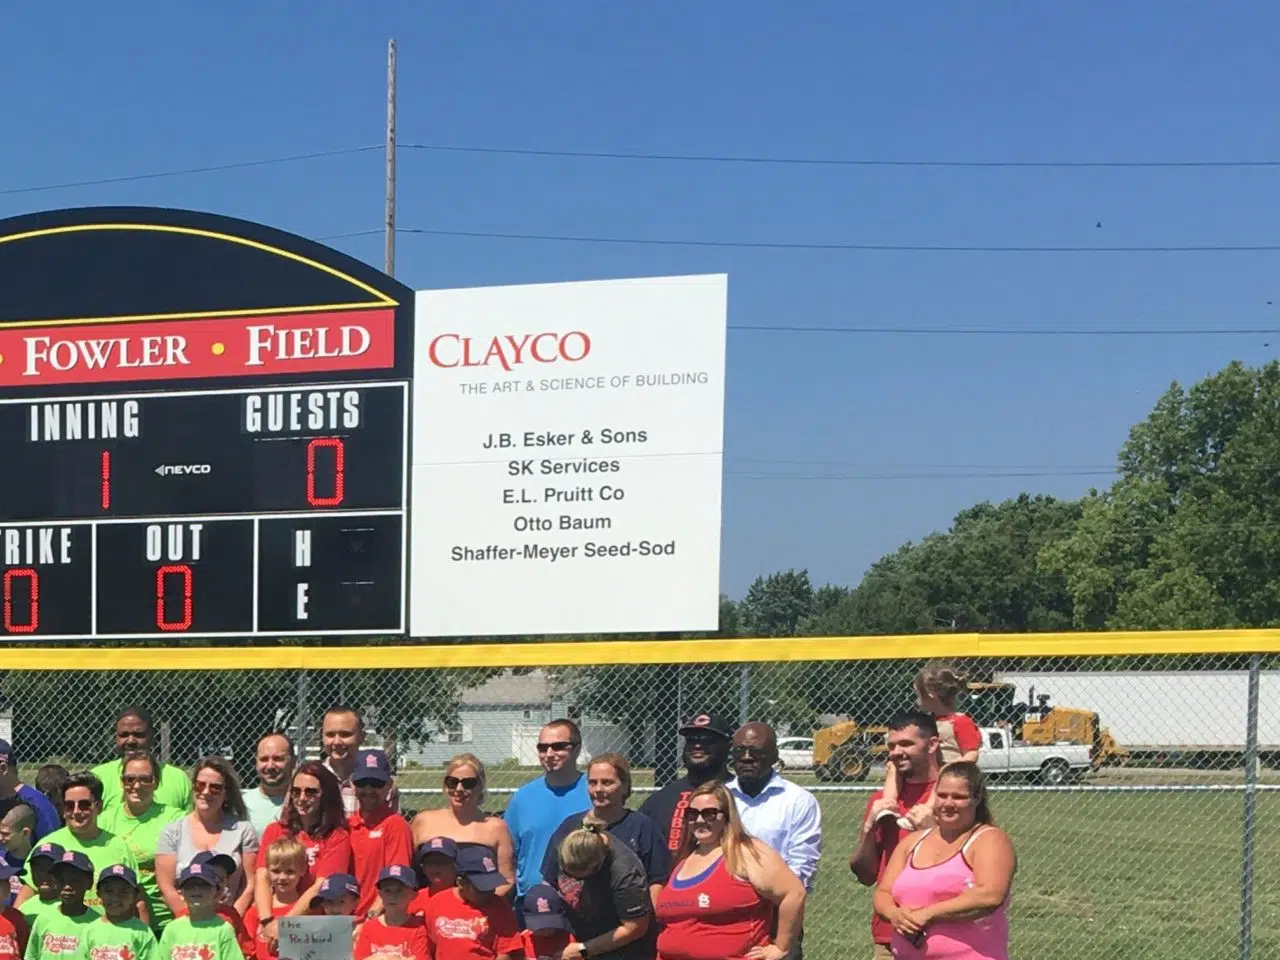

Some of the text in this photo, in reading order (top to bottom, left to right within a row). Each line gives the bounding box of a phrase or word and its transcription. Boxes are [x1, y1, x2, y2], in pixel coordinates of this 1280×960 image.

[23, 336, 190, 375] FOWLER
[245, 325, 370, 365] FIELD
[429, 331, 591, 371] CLAYCO
[460, 372, 708, 394] THE ART & SCIENCE OF BUILDING
[30, 401, 139, 439] INNING
[245, 391, 360, 433] GUESTS
[483, 429, 647, 449] J.B. Esker & Sons
[307, 437, 343, 506] 0
[509, 458, 620, 475] SK Services
[503, 486, 624, 503] E.L. Pruitt Co
[514, 516, 611, 531] Otto Baum
[146, 524, 203, 561] OUT
[296, 530, 310, 566] H
[451, 541, 675, 562] Shaffer-Meyer Seed-Sod
[4, 569, 38, 632] 0
[157, 565, 191, 630] 0
[297, 583, 308, 619] E
